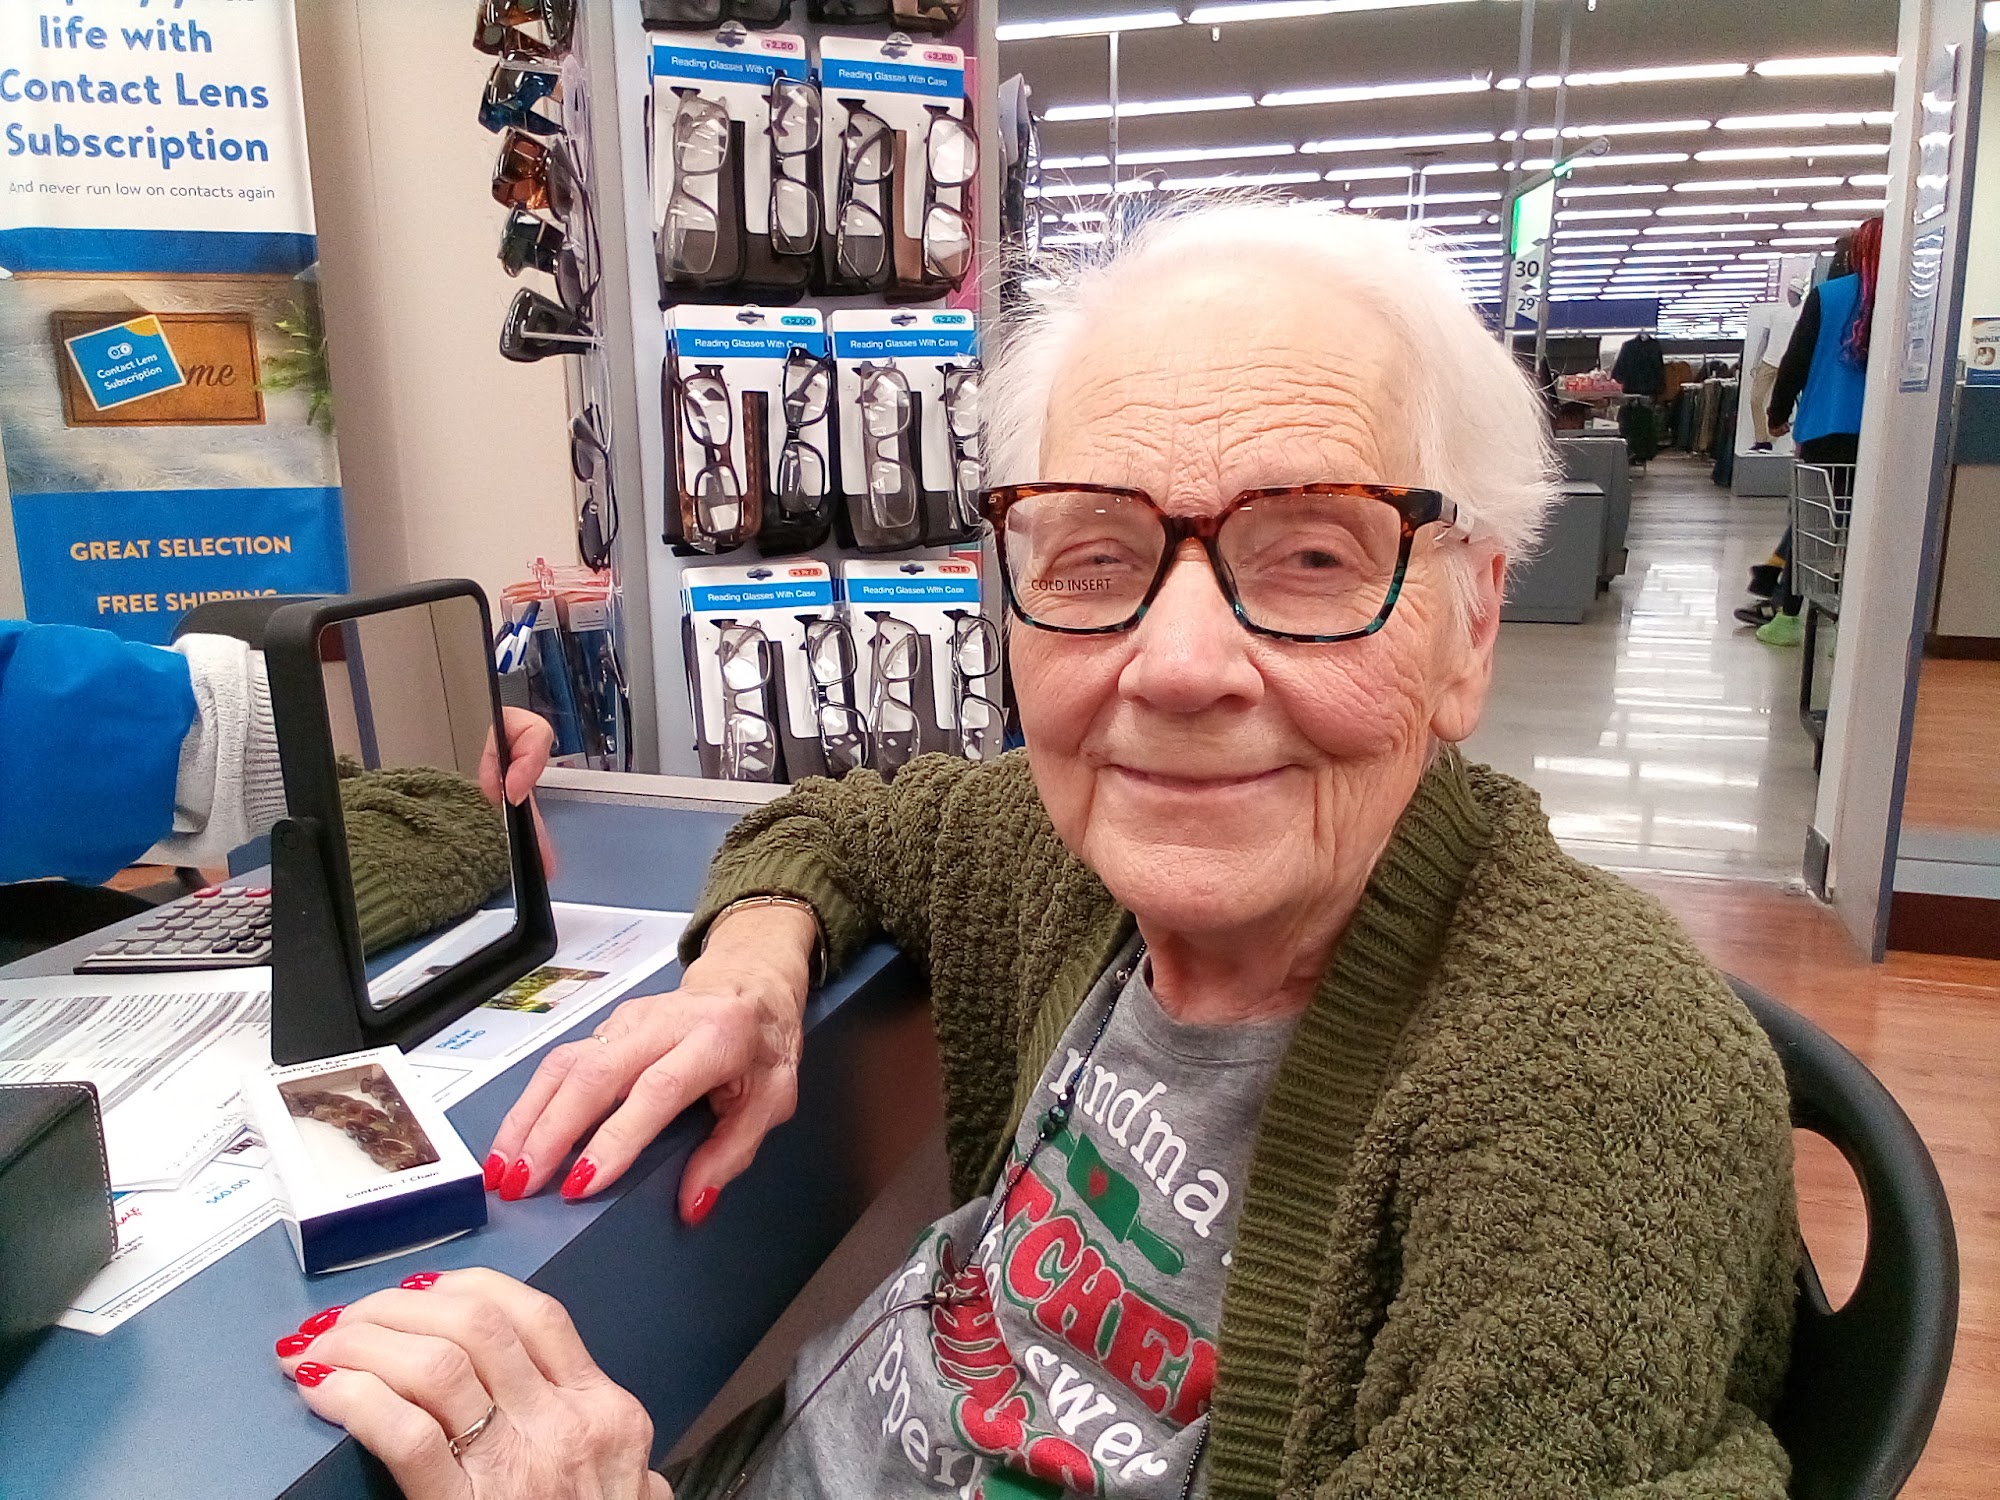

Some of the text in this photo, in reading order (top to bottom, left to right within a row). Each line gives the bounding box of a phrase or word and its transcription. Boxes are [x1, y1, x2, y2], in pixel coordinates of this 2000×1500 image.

[39, 15, 213, 53] life with
[671, 56, 707, 70] Reading
[709, 60, 743, 72] Glasses
[745, 63, 764, 74] With
[838, 68, 948, 87] Reading Glasses With Case
[0, 69, 270, 108] Contact Lens
[5, 123, 270, 169] Subscription
[9, 181, 275, 202] And never run low on contacts again
[1515, 260, 1539, 277] 30
[1518, 297, 1535, 311] 29
[695, 339, 729, 349] Reading
[731, 339, 765, 348] Glasses
[766, 339, 785, 348] With
[850, 339, 958, 350] Reading Glasses With Case
[96, 353, 158, 379] Contact Lens
[104, 366, 162, 391] Subscription
[70, 535, 292, 561] GREAT SELECTION
[863, 586, 964, 596] Reading Glasses With Case
[1031, 578, 1111, 591] COLD INSERT
[97, 593, 158, 615] FREE
[707, 589, 817, 602] Reading Glasses With Case
[271, 1064, 321, 1076] Fashion
[311, 1063, 348, 1073] Chain
[409, 1171, 439, 1182] Chain
